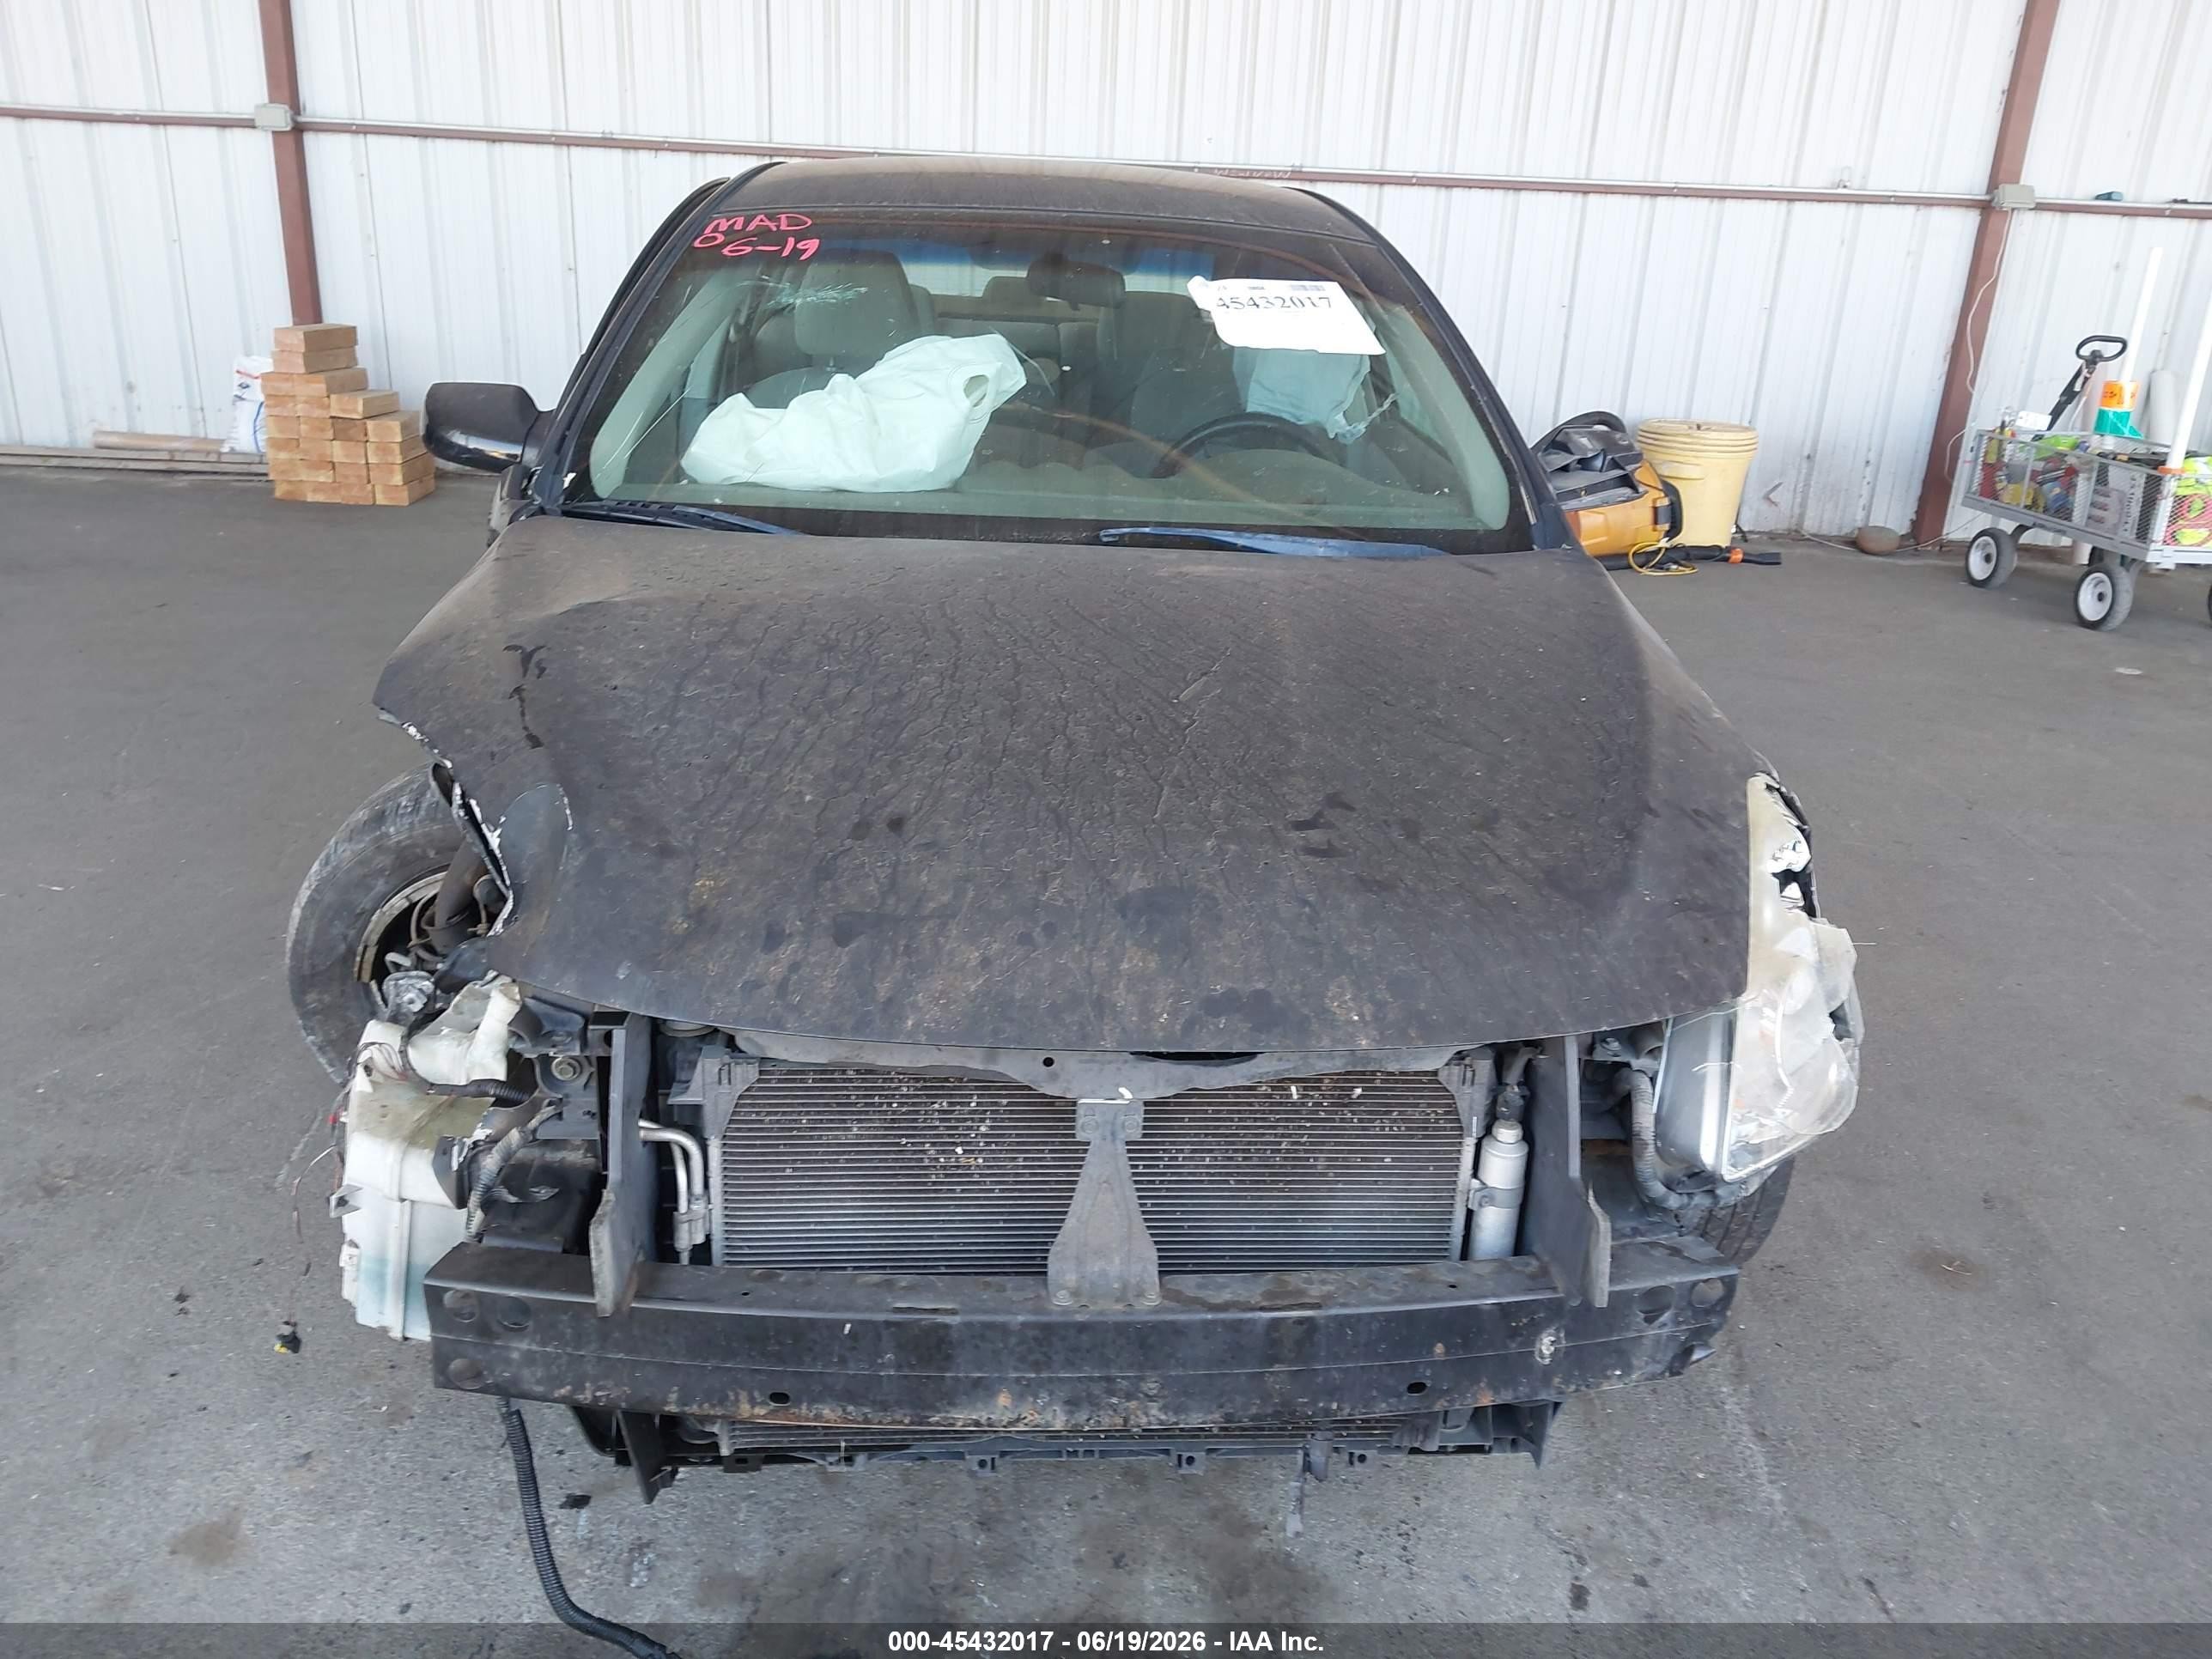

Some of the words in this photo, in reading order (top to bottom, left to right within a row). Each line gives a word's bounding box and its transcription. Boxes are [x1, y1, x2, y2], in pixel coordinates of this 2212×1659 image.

[703, 214, 812, 234] MAD
[693, 233, 820, 260] 06-19
[1215, 295, 1333, 310] 45432017
